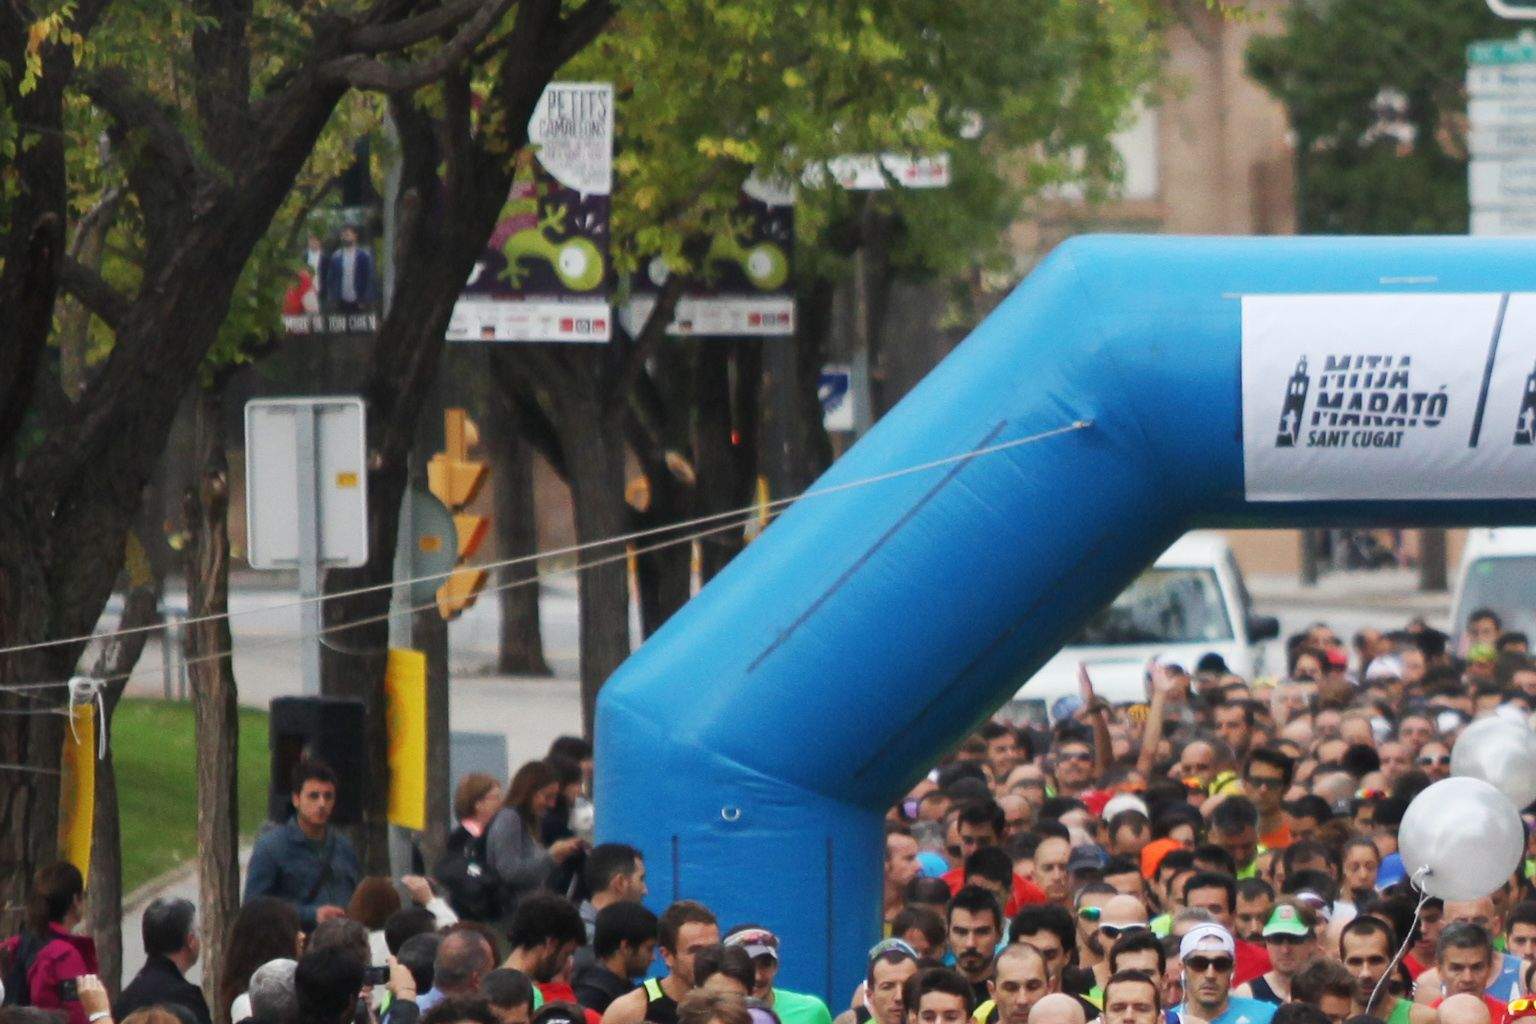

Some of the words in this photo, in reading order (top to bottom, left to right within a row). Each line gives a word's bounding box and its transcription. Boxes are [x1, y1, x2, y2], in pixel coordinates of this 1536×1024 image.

[1319, 355, 1411, 389] MITJA
[1311, 384, 1449, 428] MARATÓ
[1306, 430, 1351, 448] SANT
[1351, 430, 1405, 448] CUGAT
